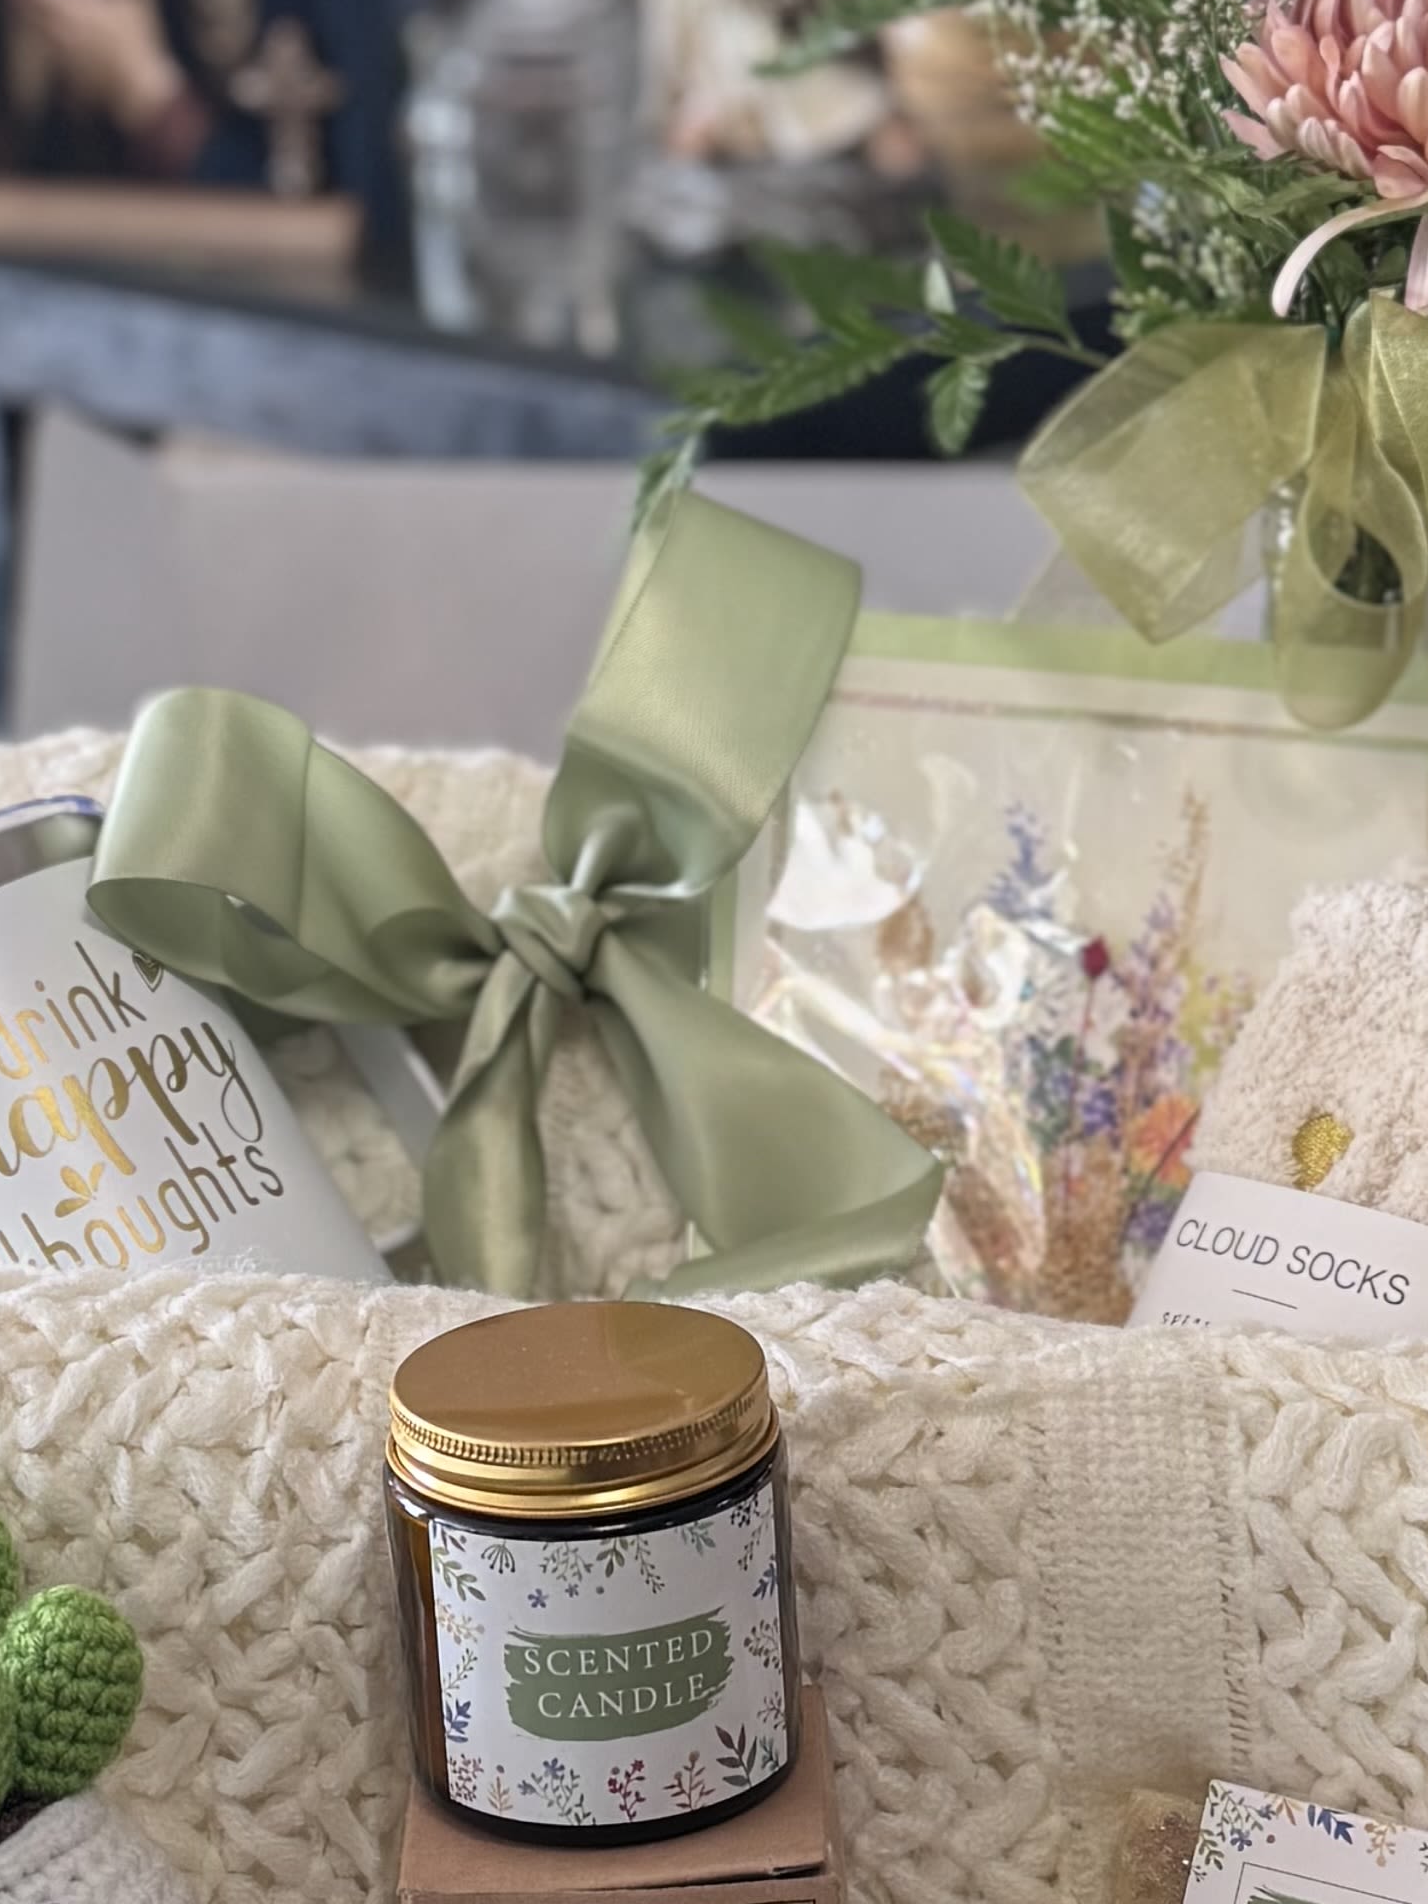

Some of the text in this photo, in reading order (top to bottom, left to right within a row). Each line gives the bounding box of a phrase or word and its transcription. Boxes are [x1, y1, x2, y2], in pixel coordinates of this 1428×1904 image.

[1176, 1218, 1410, 1306] CLOUD SOCKS
[523, 1629, 713, 1676] SCENTED
[537, 1672, 709, 1720] CANDLE
